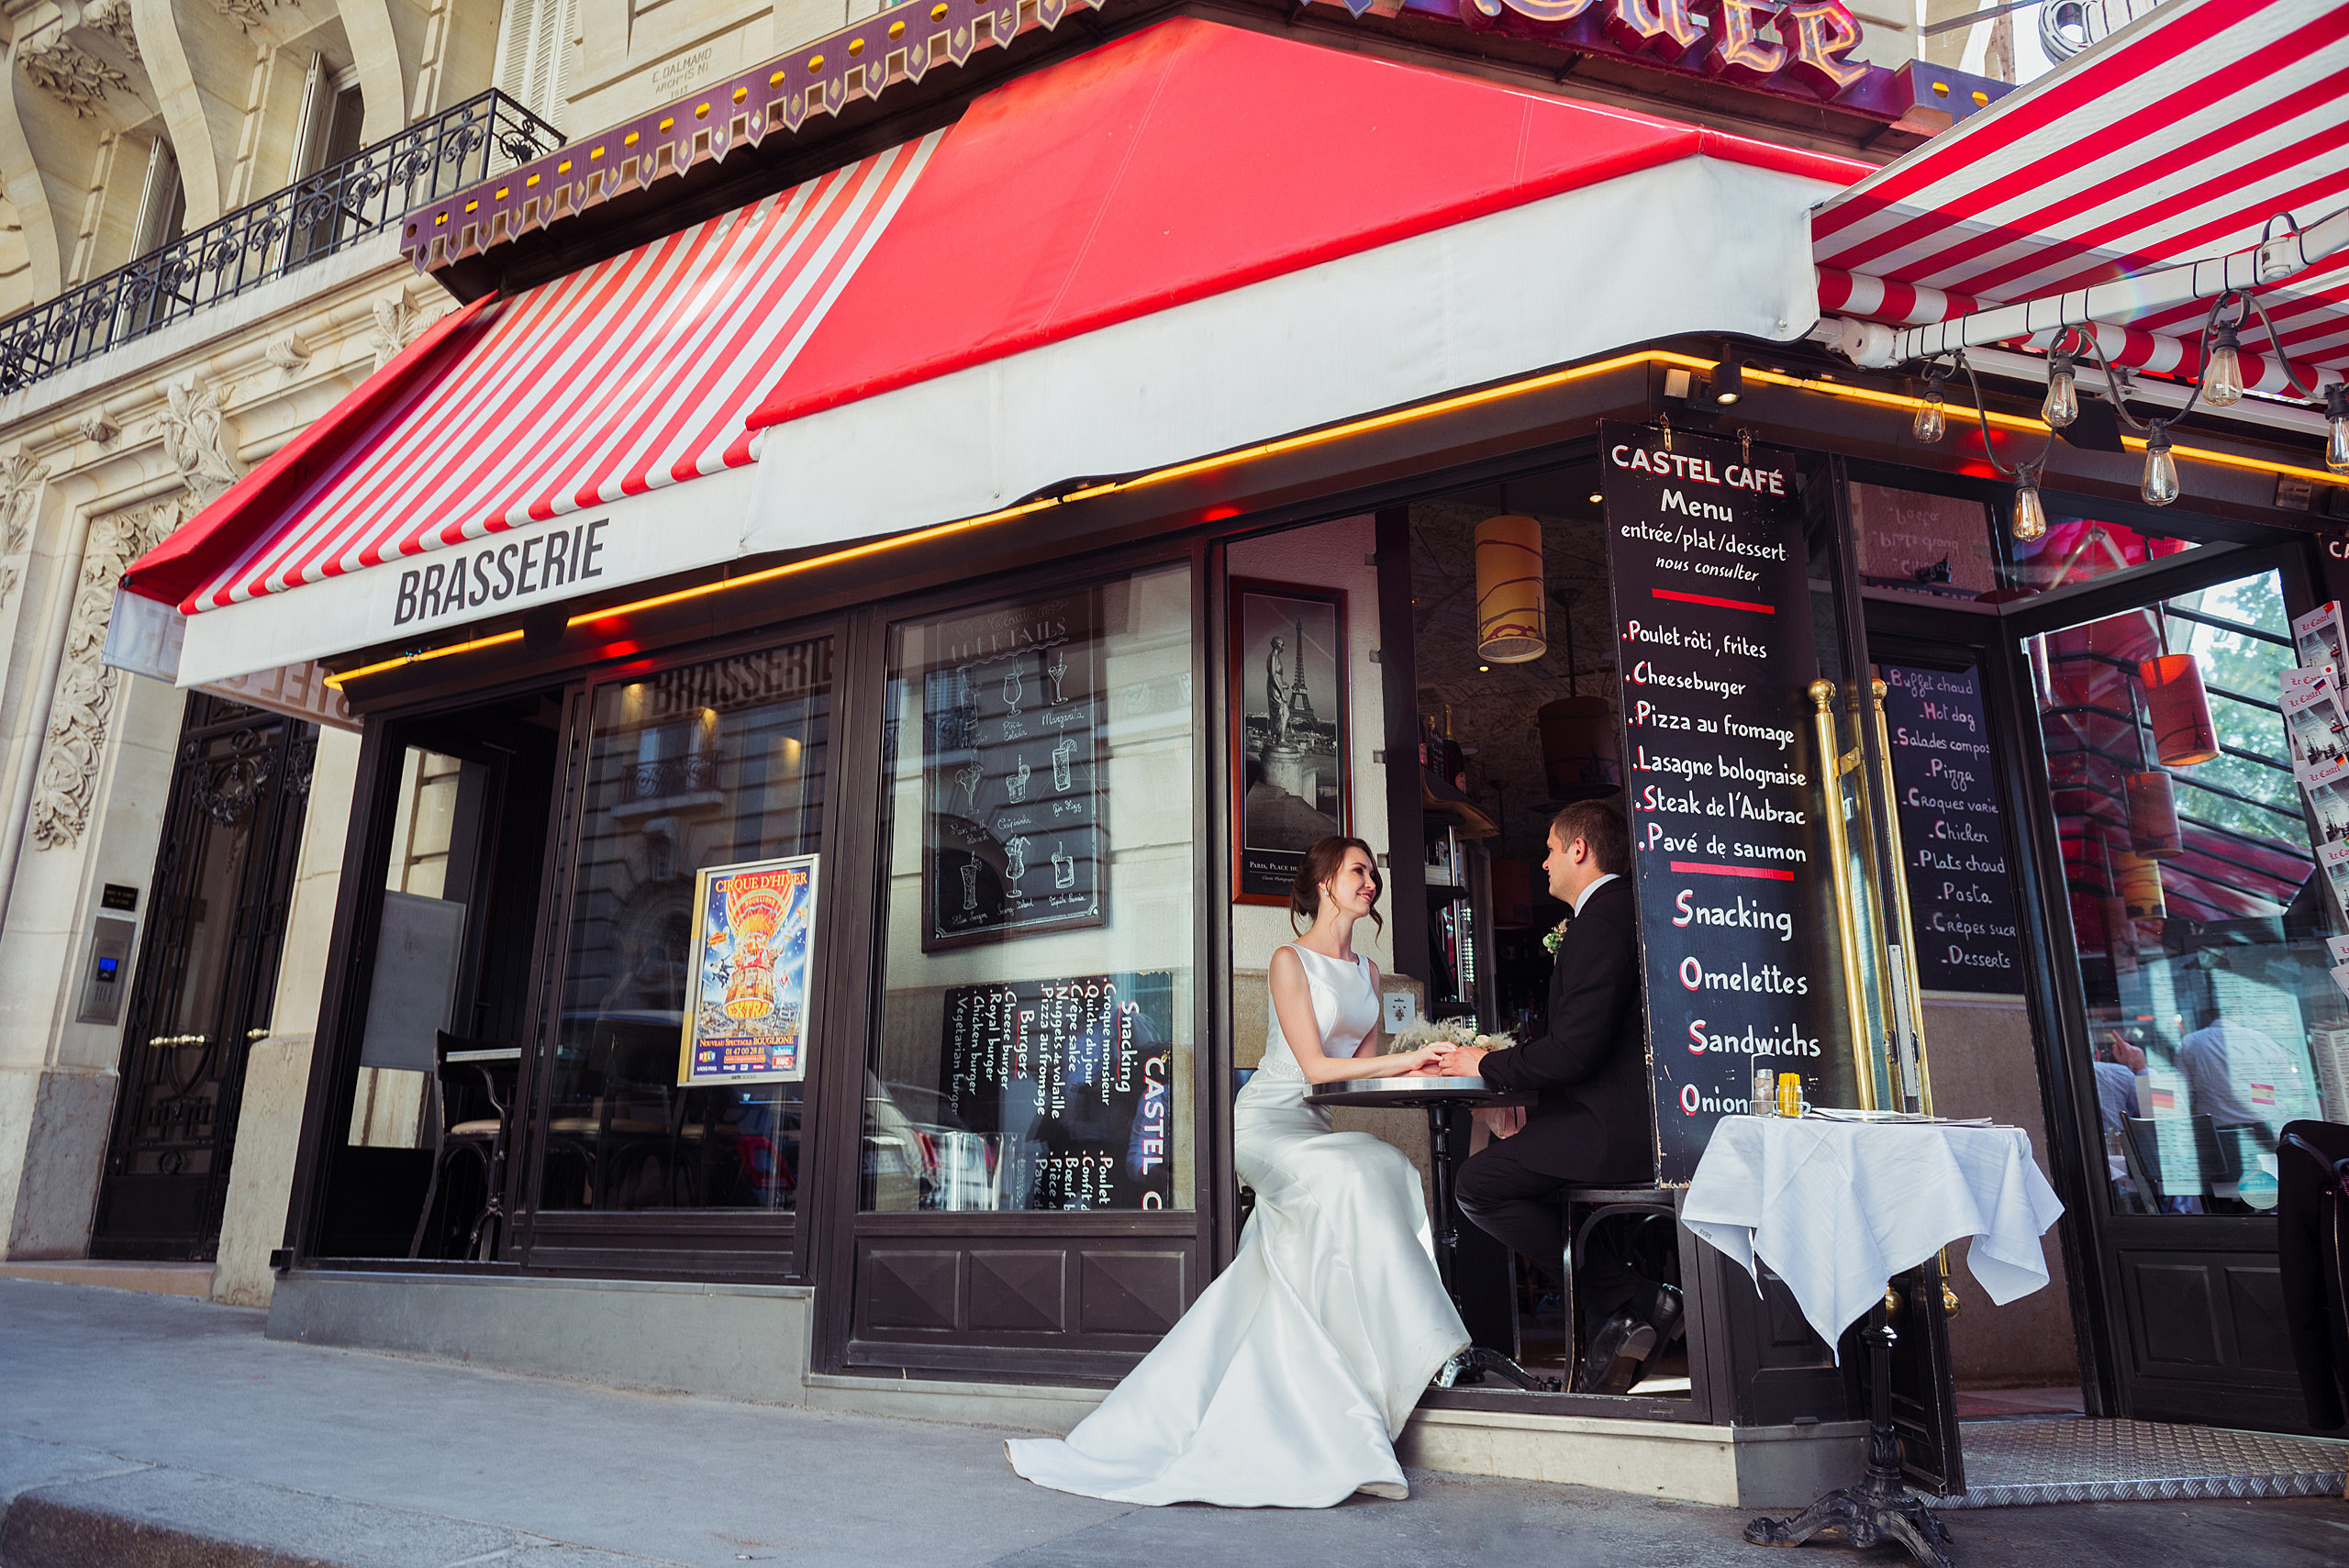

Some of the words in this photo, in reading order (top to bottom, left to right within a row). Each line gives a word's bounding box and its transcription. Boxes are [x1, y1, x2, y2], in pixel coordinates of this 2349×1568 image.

[1611, 444, 1722, 486] CASTEL
[1724, 465, 1787, 498] CAFÉ
[1660, 488, 1733, 522] Menu
[1620, 520, 1787, 562] entrée/plat/dessert
[393, 517, 610, 627] BRASSERIE
[1655, 556, 1689, 572] nous
[1694, 561, 1760, 582] consulter
[1629, 619, 1680, 646] Poulet
[1723, 635, 1767, 658] frites
[1632, 660, 1746, 699] Cheeseburger
[1890, 669, 1933, 697] Buffet
[1937, 675, 1974, 695] chaud
[1636, 700, 1691, 730] Pizza
[1697, 717, 1718, 733] au
[1723, 714, 1795, 751] fromage
[1922, 700, 1949, 720] Hot
[1952, 705, 1976, 732] dog
[1897, 726, 1948, 750] Salades
[1637, 745, 1713, 781] Lasagne
[1718, 754, 1807, 789] bolognaise
[1931, 758, 1976, 792] Pizza
[1642, 784, 1701, 815] Steak
[1706, 796, 1726, 817] de
[1648, 822, 1698, 853] Pavé
[1706, 834, 1726, 855] de
[1733, 842, 1807, 862] saumon
[1934, 819, 1989, 843] Chicken
[1919, 849, 1962, 871] Plats
[1965, 853, 2006, 873] chaud
[715, 876, 759, 894] CIRQUE
[760, 871, 808, 889] D'HIVER
[1943, 881, 1993, 905] Pasta
[1672, 888, 1793, 941] Snacking
[1678, 956, 1809, 995] Omelettes
[726, 1000, 770, 1019] EXTRA
[970, 995, 985, 1048] Chicken
[985, 993, 1002, 1031] Royal
[1003, 990, 1018, 1041] Cheese
[1040, 986, 1053, 1029] Pizza
[1050, 985, 1069, 1050] Nuggets
[1066, 983, 1084, 1031] Crêpe
[1084, 984, 1099, 1036] Quiche
[1099, 983, 1117, 1036] Croque
[725, 1048, 732, 1056] 01
[733, 1047, 740, 1055] 47
[741, 1047, 750, 1055] 00
[750, 1047, 758, 1055] 28
[758, 1046, 765, 1054] 81
[752, 1036, 795, 1046] BOUGLIONE
[952, 996, 969, 1069] Vegetarian
[1014, 1010, 1035, 1080] Burgers
[1039, 1033, 1049, 1051] au
[1085, 1038, 1097, 1055] du
[1116, 999, 1140, 1093] Snacking
[1687, 1019, 1821, 1057] Sandwichs
[966, 1051, 983, 1095] burger
[984, 1038, 1000, 1082] burger
[996, 1044, 1013, 1091] burger
[1054, 1051, 1063, 1065] de
[1068, 1034, 1081, 1073] salée
[1080, 1054, 1098, 1087] jour
[1101, 1038, 1115, 1106] monsieur
[948, 1073, 964, 1116] burger
[1033, 1053, 1052, 1116] fromage
[1051, 1066, 1066, 1119] volaille
[1679, 1084, 1749, 1117] Onion
[1141, 1056, 1165, 1175] CASTEL
[1033, 1159, 1048, 1196] Pavé
[1049, 1159, 1063, 1197] Pièce
[1081, 1155, 1095, 1202] Confit
[1098, 1157, 1114, 1205] Poulet
